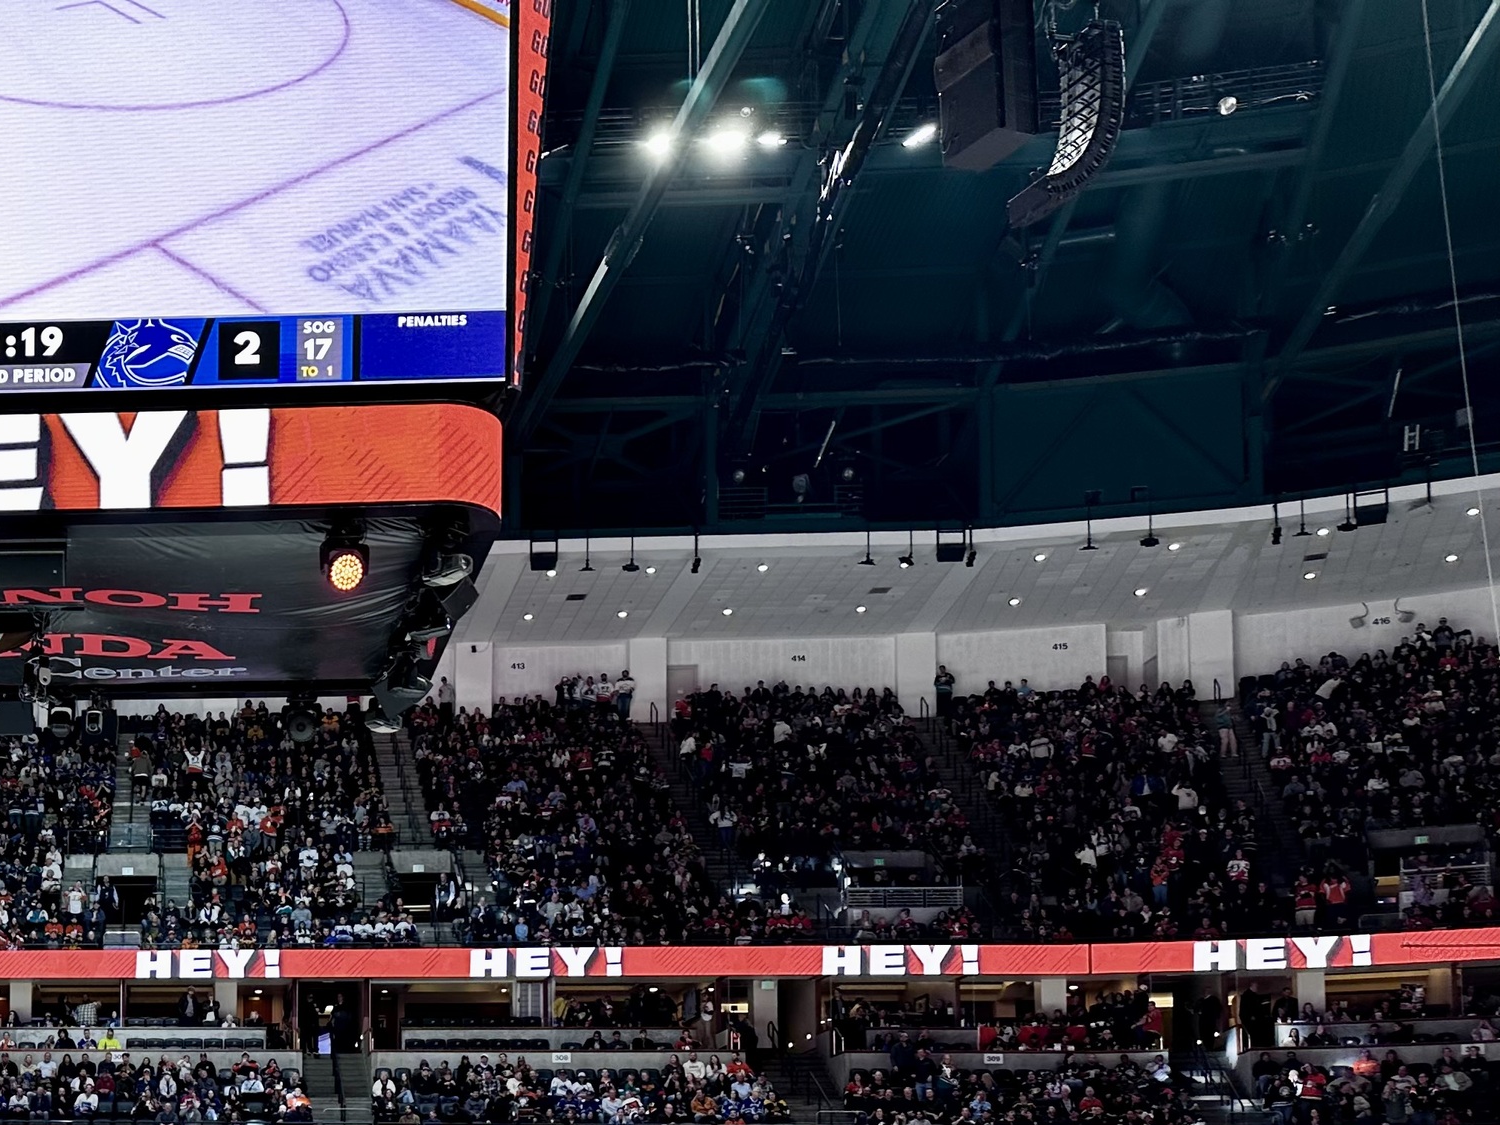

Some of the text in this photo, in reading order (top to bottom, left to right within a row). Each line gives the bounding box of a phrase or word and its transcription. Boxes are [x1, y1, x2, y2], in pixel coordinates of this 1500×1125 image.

[303, 320, 335, 334] SOG
[398, 314, 467, 328] PENALTIES
[234, 330, 261, 365] 2
[304, 338, 333, 360] 17
[12, 367, 75, 384] PERIOD
[301, 366, 334, 378] TO 1
[1372, 616, 1391, 625] 416
[1052, 642, 1068, 650] 415
[27, 655, 247, 681] Center
[511, 662, 525, 670] 413
[470, 946, 623, 978] HEY!
[821, 944, 979, 976] HEY!
[1193, 934, 1372, 972] HEY!
[136, 948, 280, 979] HEY!
